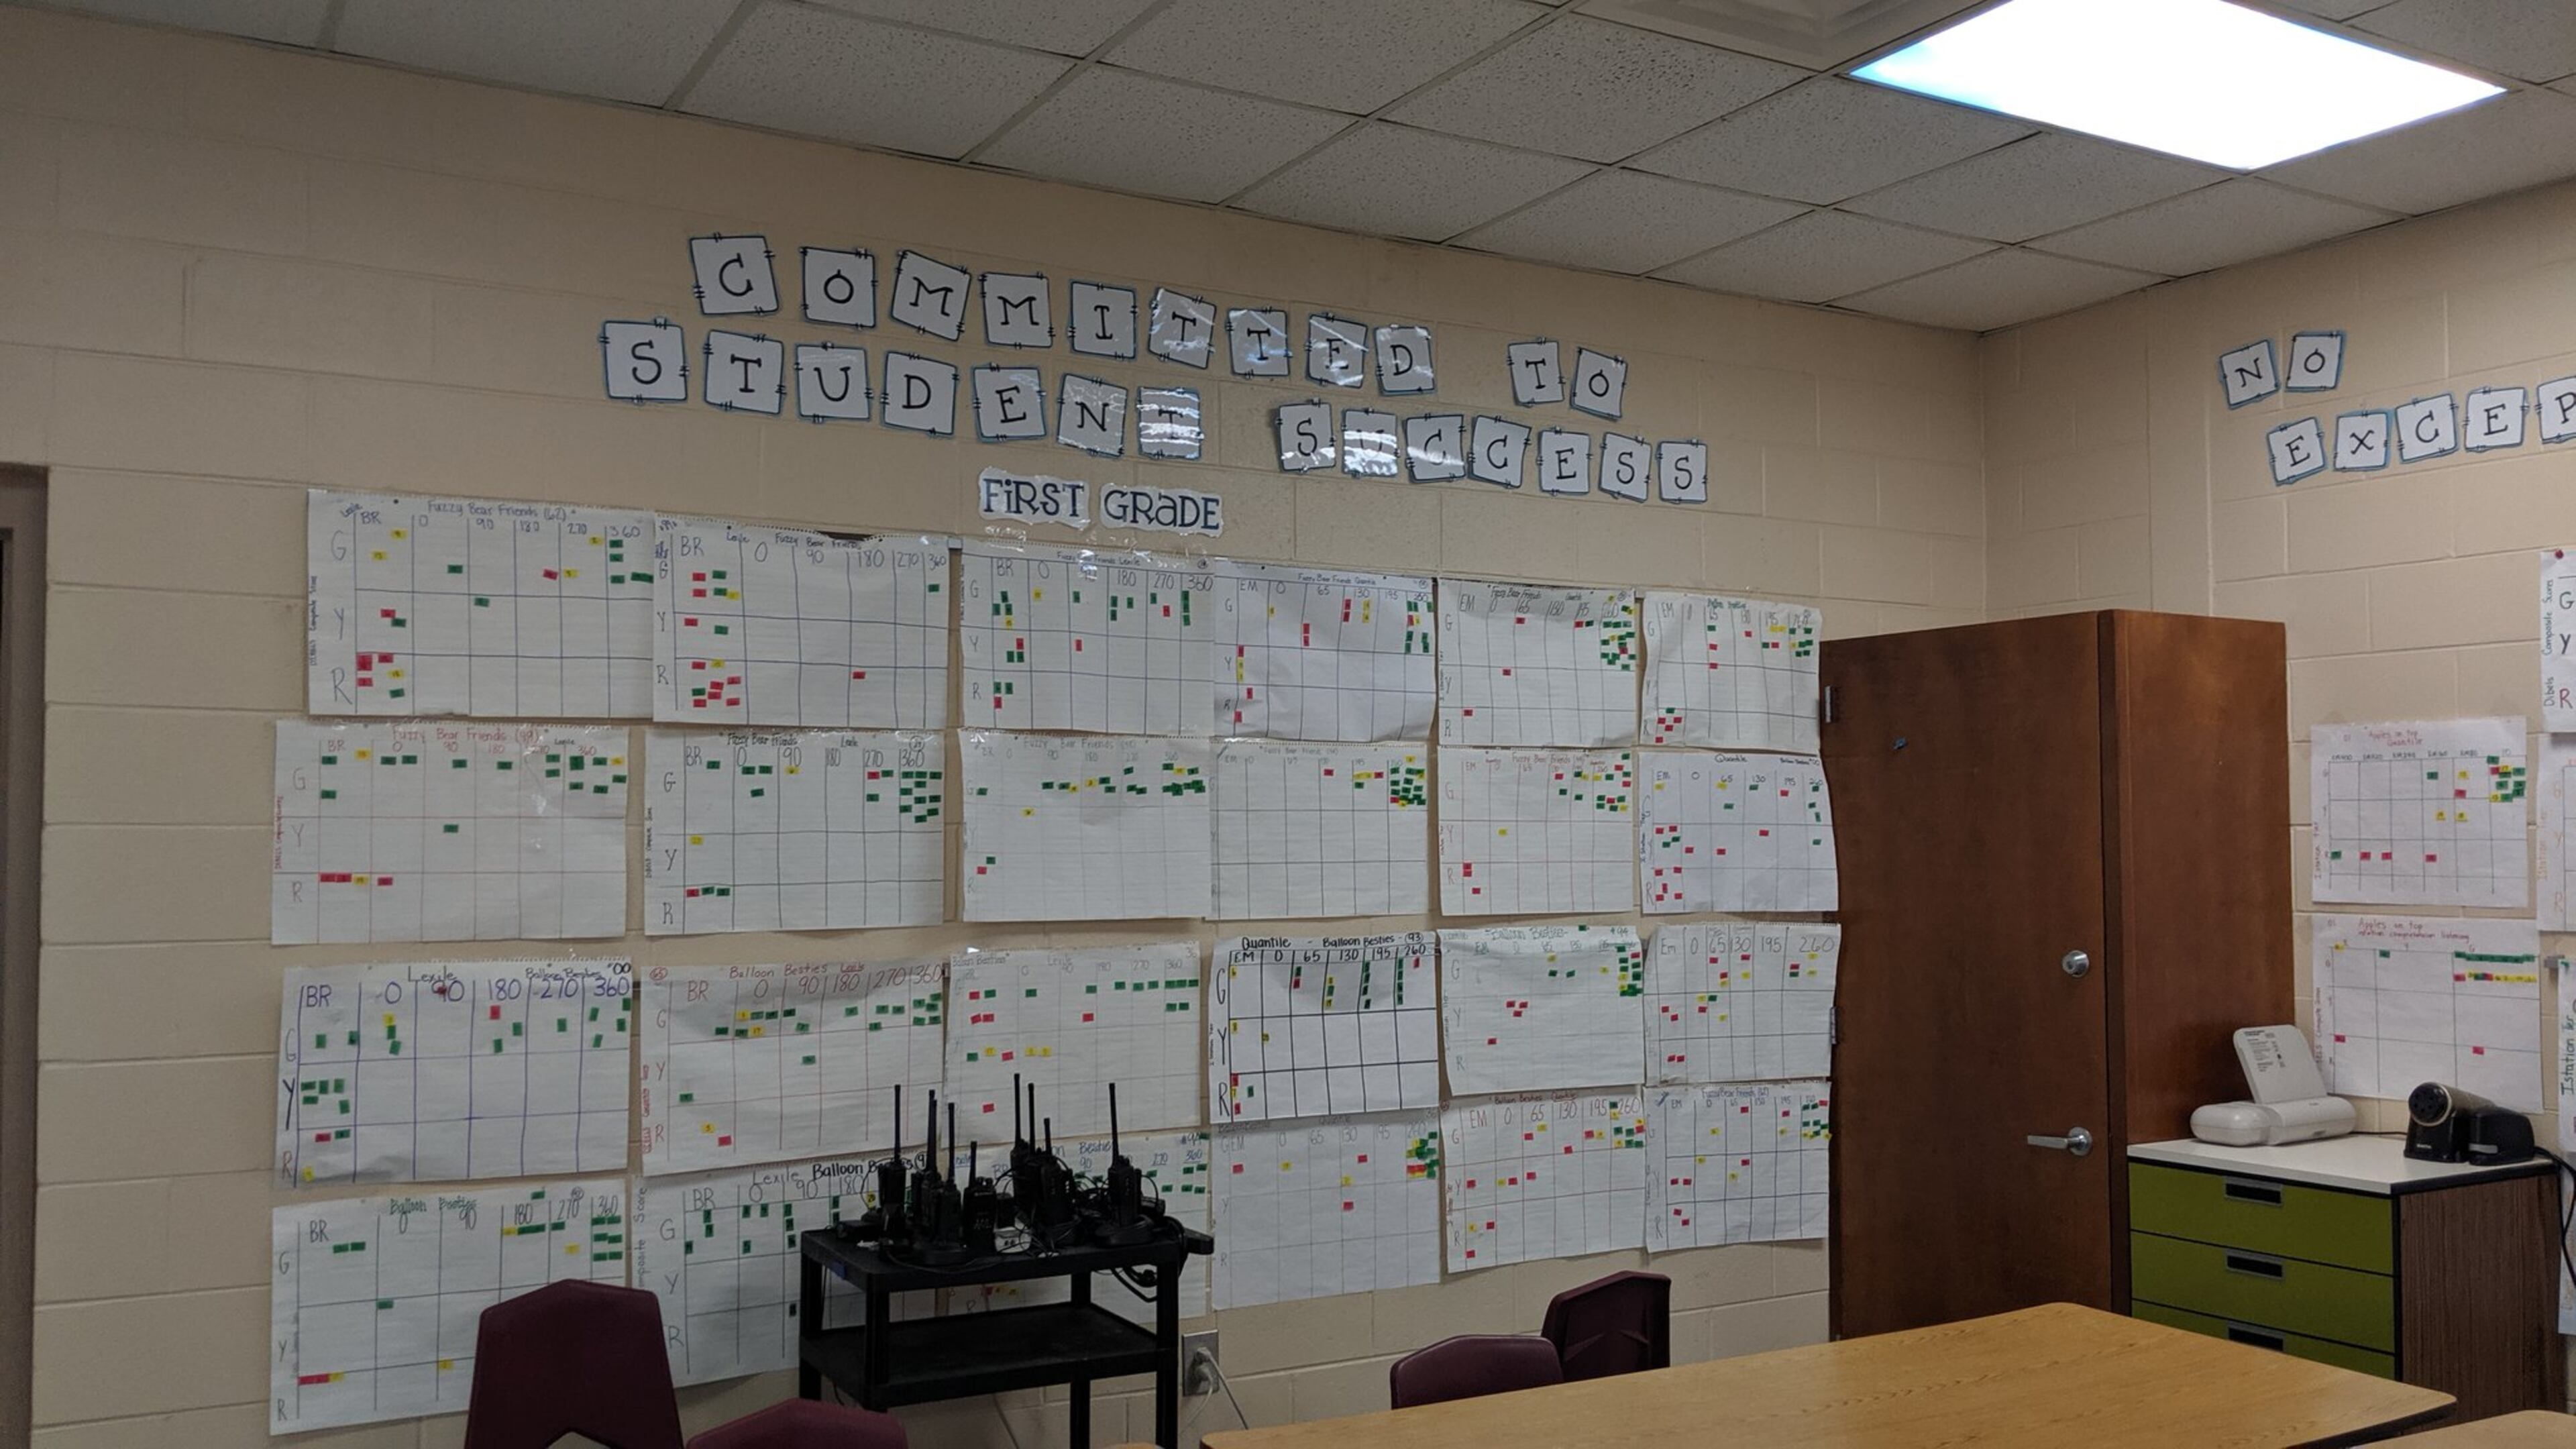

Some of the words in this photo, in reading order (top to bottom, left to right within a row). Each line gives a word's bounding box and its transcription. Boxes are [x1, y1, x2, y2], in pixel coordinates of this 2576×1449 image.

[719, 254, 1413, 376] COMMITTED
[1525, 358, 1609, 397] TO
[2235, 348, 2326, 388] NO
[631, 340, 1183, 439] STUDENT
[1297, 417, 1692, 490] SUCCESS
[428, 500, 464, 515] Fuzzy
[361, 512, 380, 525] BR
[476, 519, 494, 531] 90
[610, 526, 640, 537] 360
[331, 531, 347, 561] G
[680, 537, 704, 557] BR
[807, 550, 824, 564] 90
[857, 550, 884, 568] 180
[898, 551, 918, 567] 270
[928, 552, 946, 566] 360
[970, 580, 978, 598] G
[1117, 570, 1136, 586] 180
[1154, 573, 1174, 589] 270
[1189, 575, 1214, 592] 360
[1240, 582, 1258, 592] EM
[1318, 586, 1330, 596] 65
[1460, 594, 1475, 612] EM
[2560, 592, 2575, 609] G
[335, 608, 344, 640] Y
[658, 612, 665, 631] Y
[1445, 614, 1452, 631] G
[1648, 621, 1654, 636] G
[970, 635, 978, 652] Y
[657, 665, 669, 684] R
[332, 668, 352, 705] R
[973, 684, 981, 700] R
[2560, 688, 2573, 709] R
[686, 747, 702, 767] BR
[784, 747, 802, 767] 90
[865, 750, 883, 767] 270
[901, 748, 925, 767] 360
[293, 767, 307, 790] G
[663, 771, 676, 793] G
[1752, 775, 1766, 783] 130
[292, 823, 305, 847] Y
[665, 848, 678, 871] Y
[292, 881, 303, 903] R
[662, 902, 674, 925] R
[1234, 952, 1254, 963] EM
[1303, 952, 1321, 961] 65
[1340, 950, 1359, 960] 130
[1373, 947, 1391, 959] 195
[1405, 945, 1426, 955] 260
[1242, 937, 1291, 949] Quantile
[1323, 938, 1360, 947] Balloon
[1363, 936, 1395, 947] Besties
[1710, 938, 1727, 953] 65
[1731, 937, 1751, 953] 130
[1761, 937, 1782, 953] 195
[1799, 938, 1835, 953] 260
[730, 967, 774, 979] Balloon
[784, 964, 828, 976] Besties
[306, 985, 332, 1008] BR
[384, 981, 402, 1004] 0
[431, 979, 465, 1003] 90
[489, 979, 521, 1000] 180
[540, 977, 579, 999] 270
[594, 976, 630, 996] 360
[688, 981, 708, 1002] BR
[754, 981, 769, 998] 0
[798, 979, 819, 995] 90
[833, 973, 859, 992] 180
[873, 969, 906, 989] 270
[914, 965, 941, 983] 360
[1216, 968, 1226, 1005] G
[286, 1028, 297, 1063] G
[1217, 1027, 1227, 1065] Y
[282, 1078, 295, 1130] Y
[1218, 1082, 1230, 1118] R
[1470, 1110, 1487, 1128] EM
[1530, 1106, 1544, 1121] 65
[1559, 1103, 1577, 1119] 130
[1590, 1099, 1607, 1116] 195
[1618, 1097, 1640, 1114] 260
[282, 1151, 292, 1178] R
[752, 1171, 799, 1187] Lexile
[812, 1161, 864, 1180] Balloon
[693, 1187, 716, 1210] BR
[796, 1181, 818, 1199] 90
[839, 1175, 864, 1196] 180
[633, 1187, 648, 1224] Score
[310, 1219, 329, 1243] BR
[460, 1206, 477, 1230] 90
[515, 1203, 533, 1224] 180
[659, 1219, 676, 1241] G
[664, 1274, 679, 1295] Y
